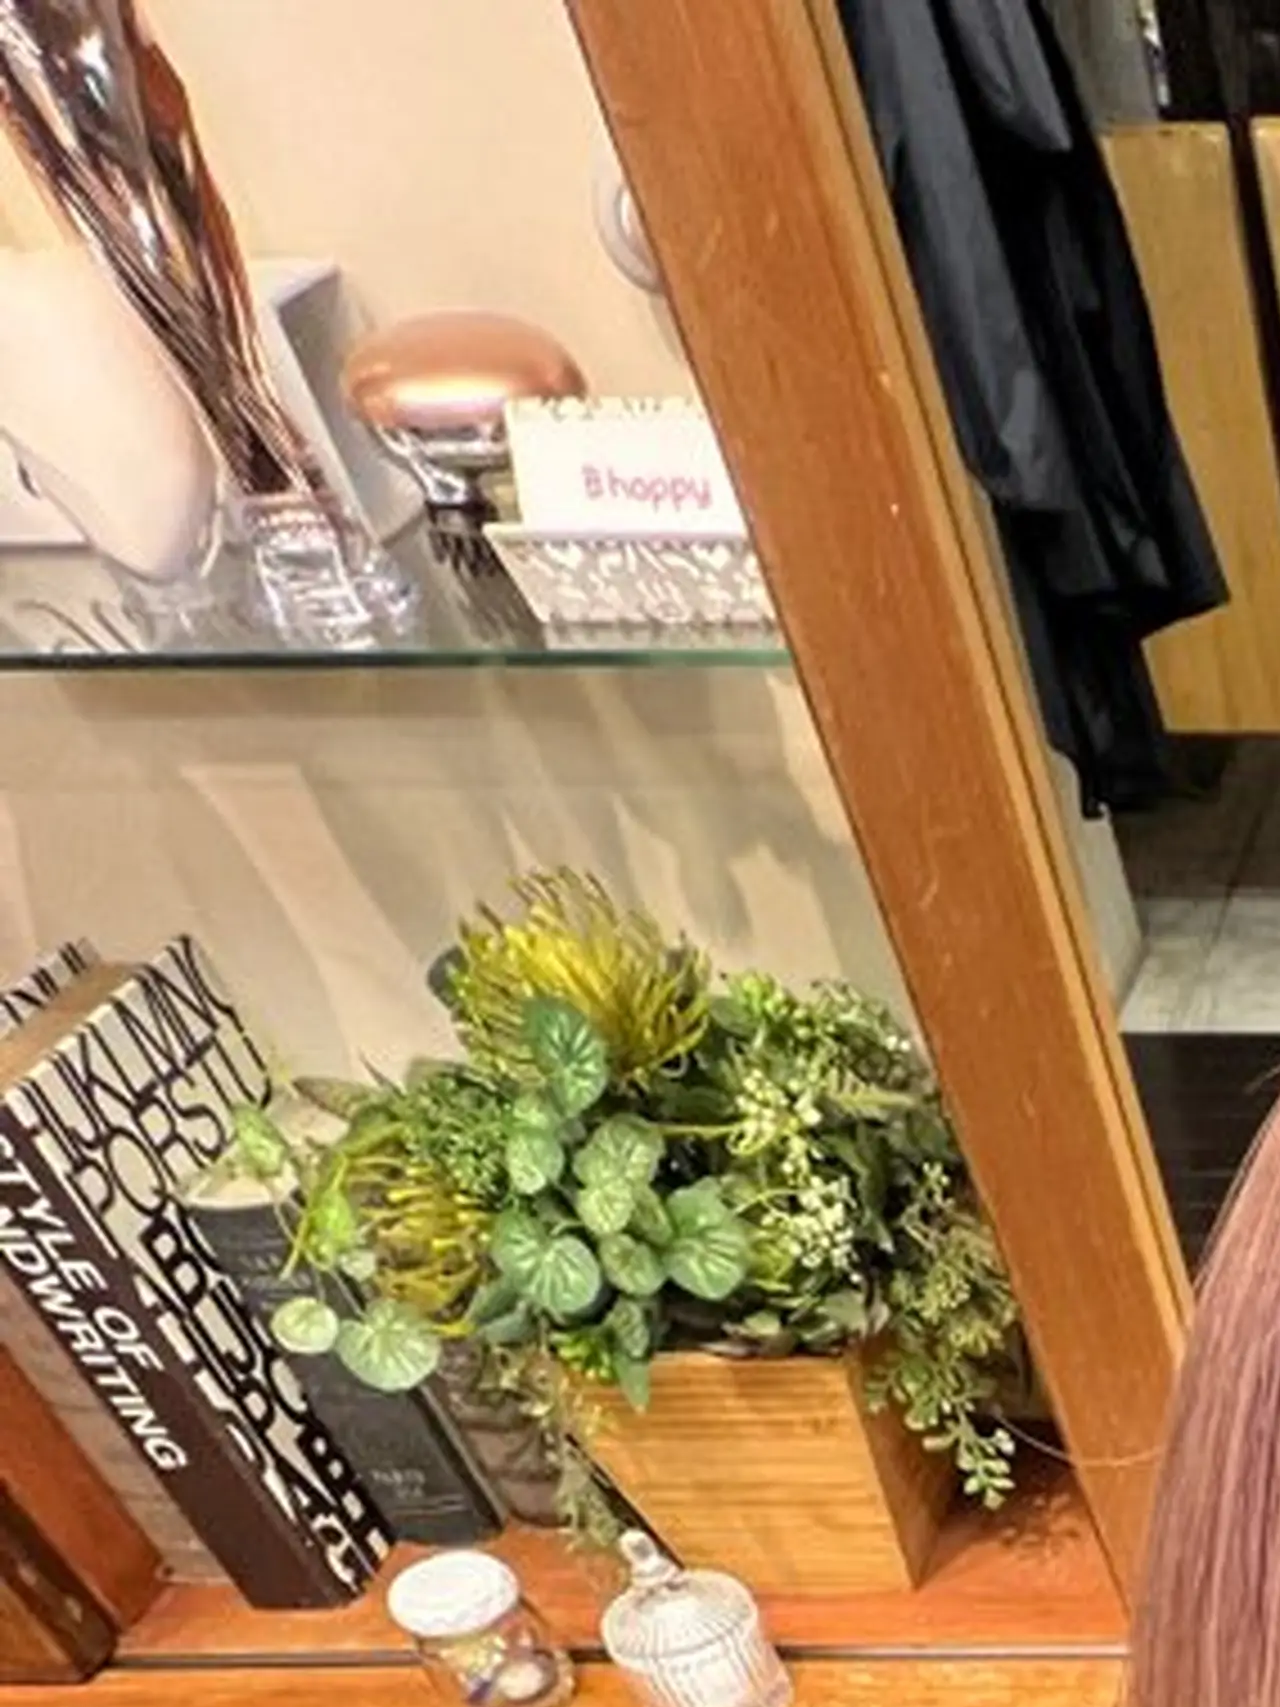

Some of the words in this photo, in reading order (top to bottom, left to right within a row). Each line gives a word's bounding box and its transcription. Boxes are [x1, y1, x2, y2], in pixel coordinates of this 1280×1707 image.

[607, 466, 713, 513] happy
[0, 1205, 189, 1471] NDWRITING
[93, 1305, 165, 1372] OF
